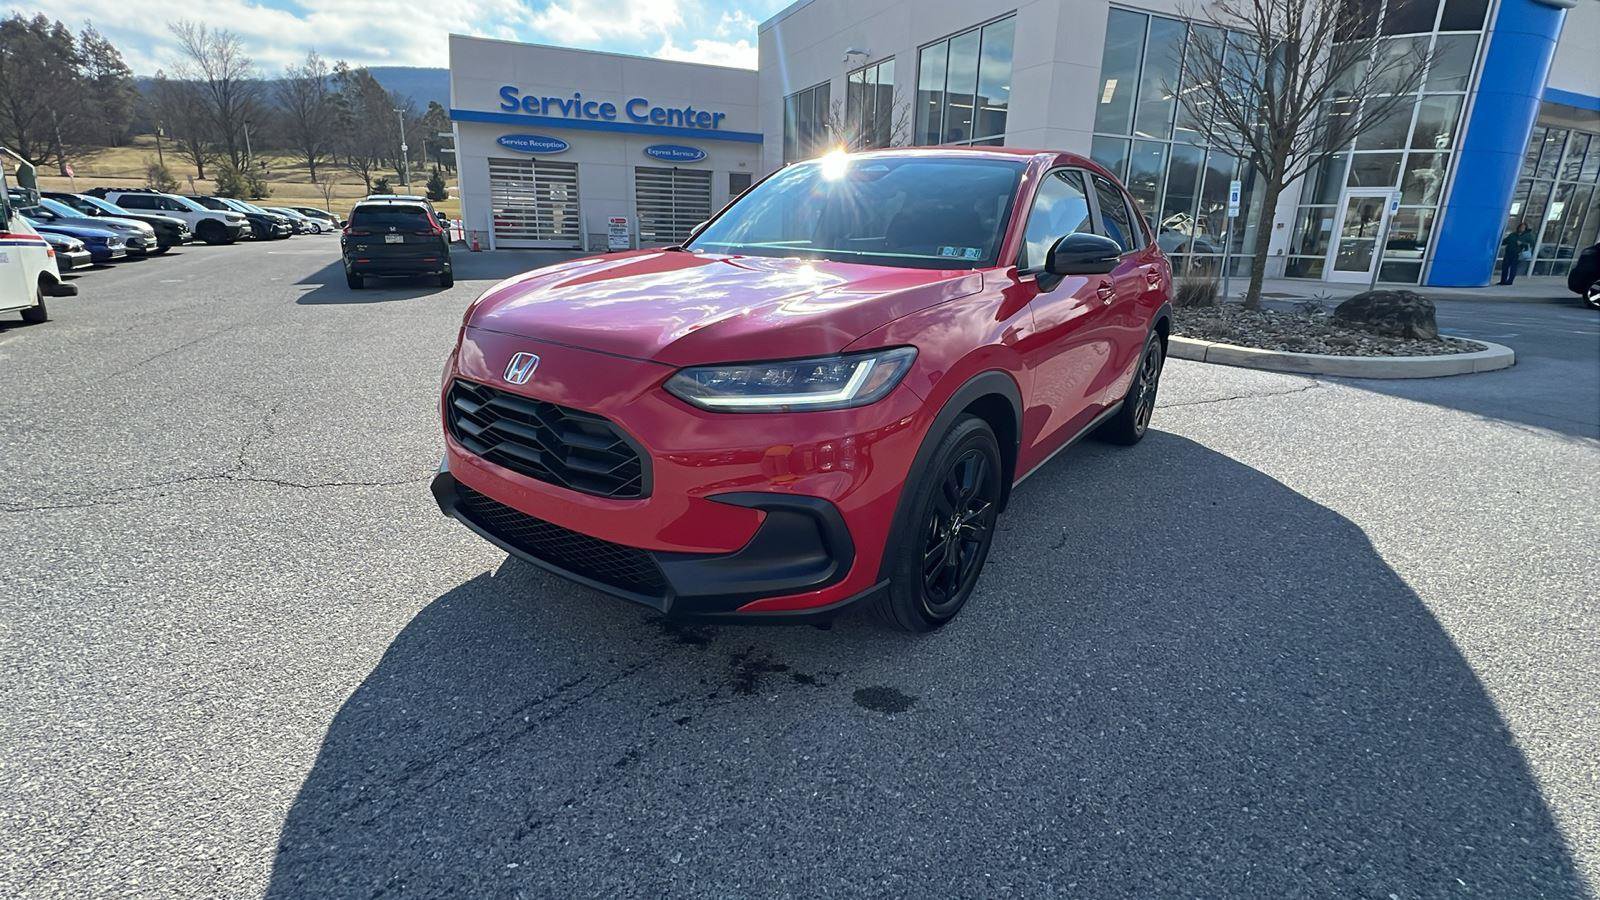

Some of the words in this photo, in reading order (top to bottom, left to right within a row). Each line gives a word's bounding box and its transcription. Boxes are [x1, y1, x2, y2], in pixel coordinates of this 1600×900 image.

[499, 85, 617, 119] Service
[625, 97, 726, 129] Center
[501, 138, 528, 146] Service
[529, 140, 565, 148] Reception
[647, 148, 671, 156] Express
